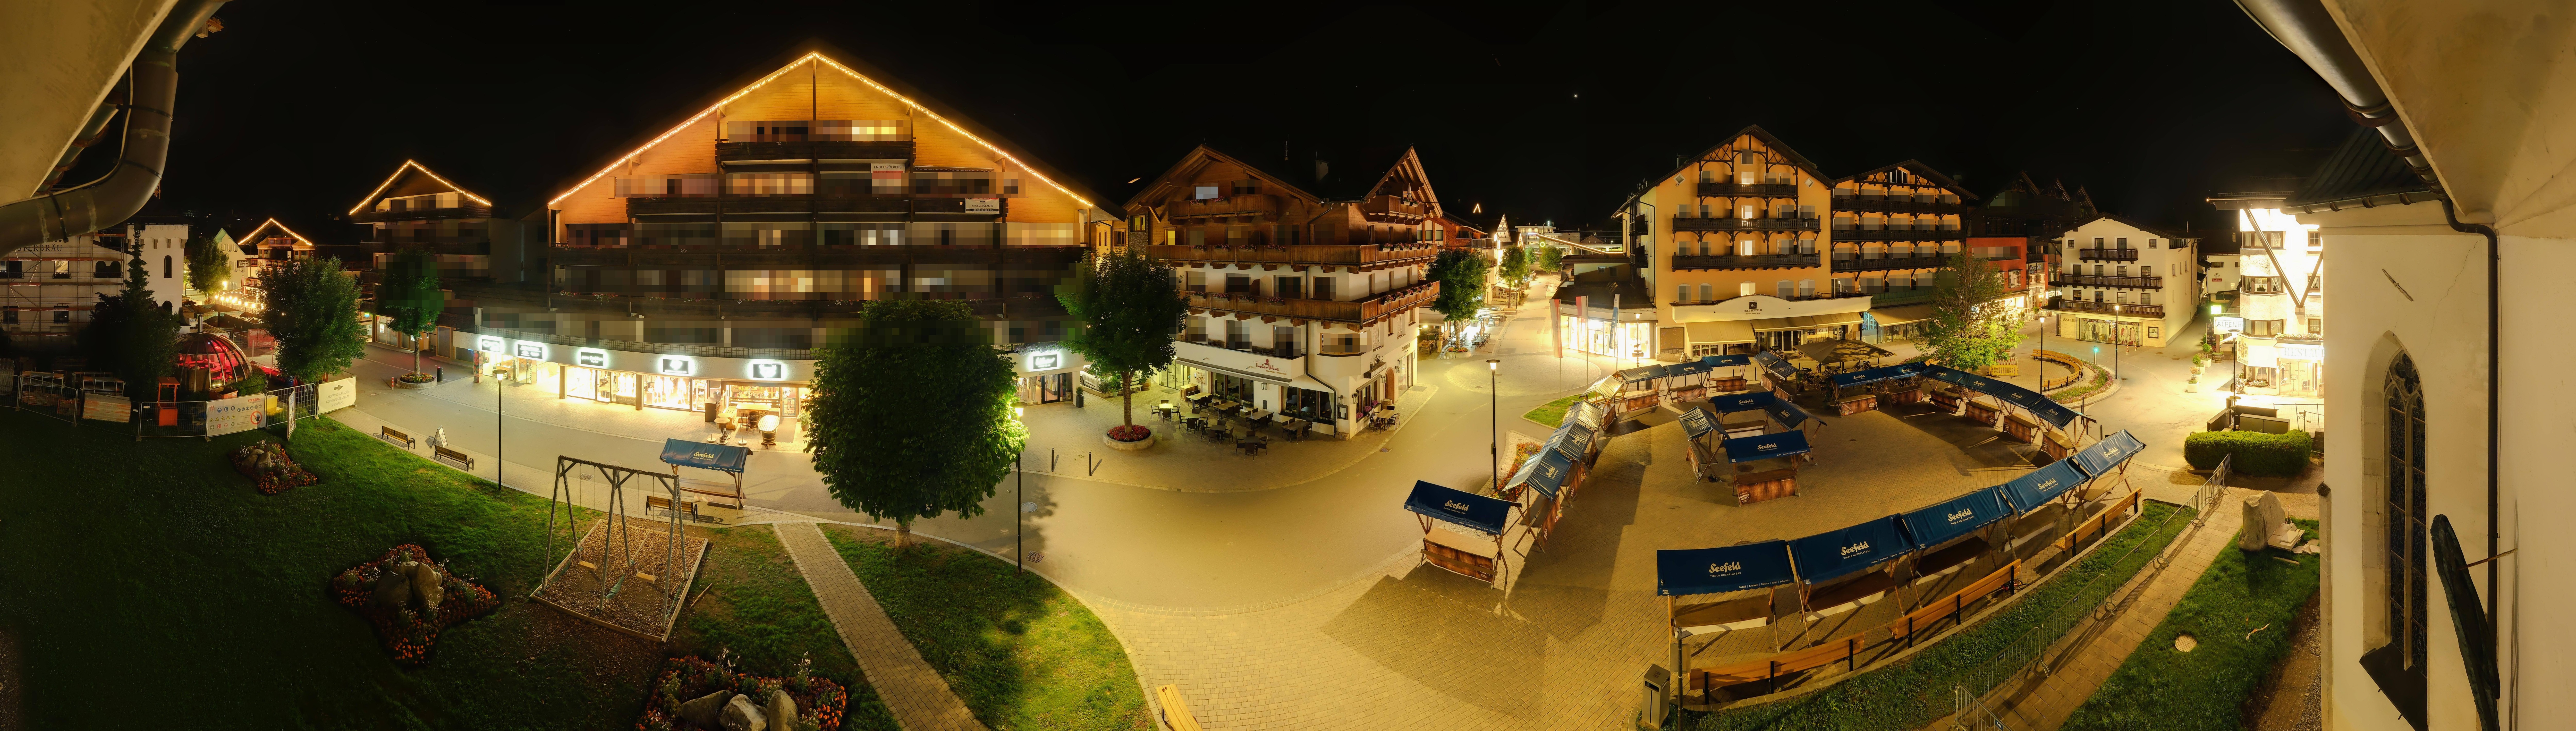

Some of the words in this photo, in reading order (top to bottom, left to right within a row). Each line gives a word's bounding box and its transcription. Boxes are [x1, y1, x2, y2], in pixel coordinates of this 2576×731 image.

[1402, 343, 1410, 351] SAILER
[1371, 364, 1385, 377] RESTAURANT
[326, 395, 349, 403] KONGRESSZENTRUM
[2104, 447, 2118, 457] Seefeld
[2038, 478, 2056, 490] Seefeld
[1445, 500, 1469, 511] Seefeld
[1948, 508, 1972, 522] Seefeld
[1841, 541, 1869, 556] Seefeld
[1709, 561, 1741, 573] Seefeld
